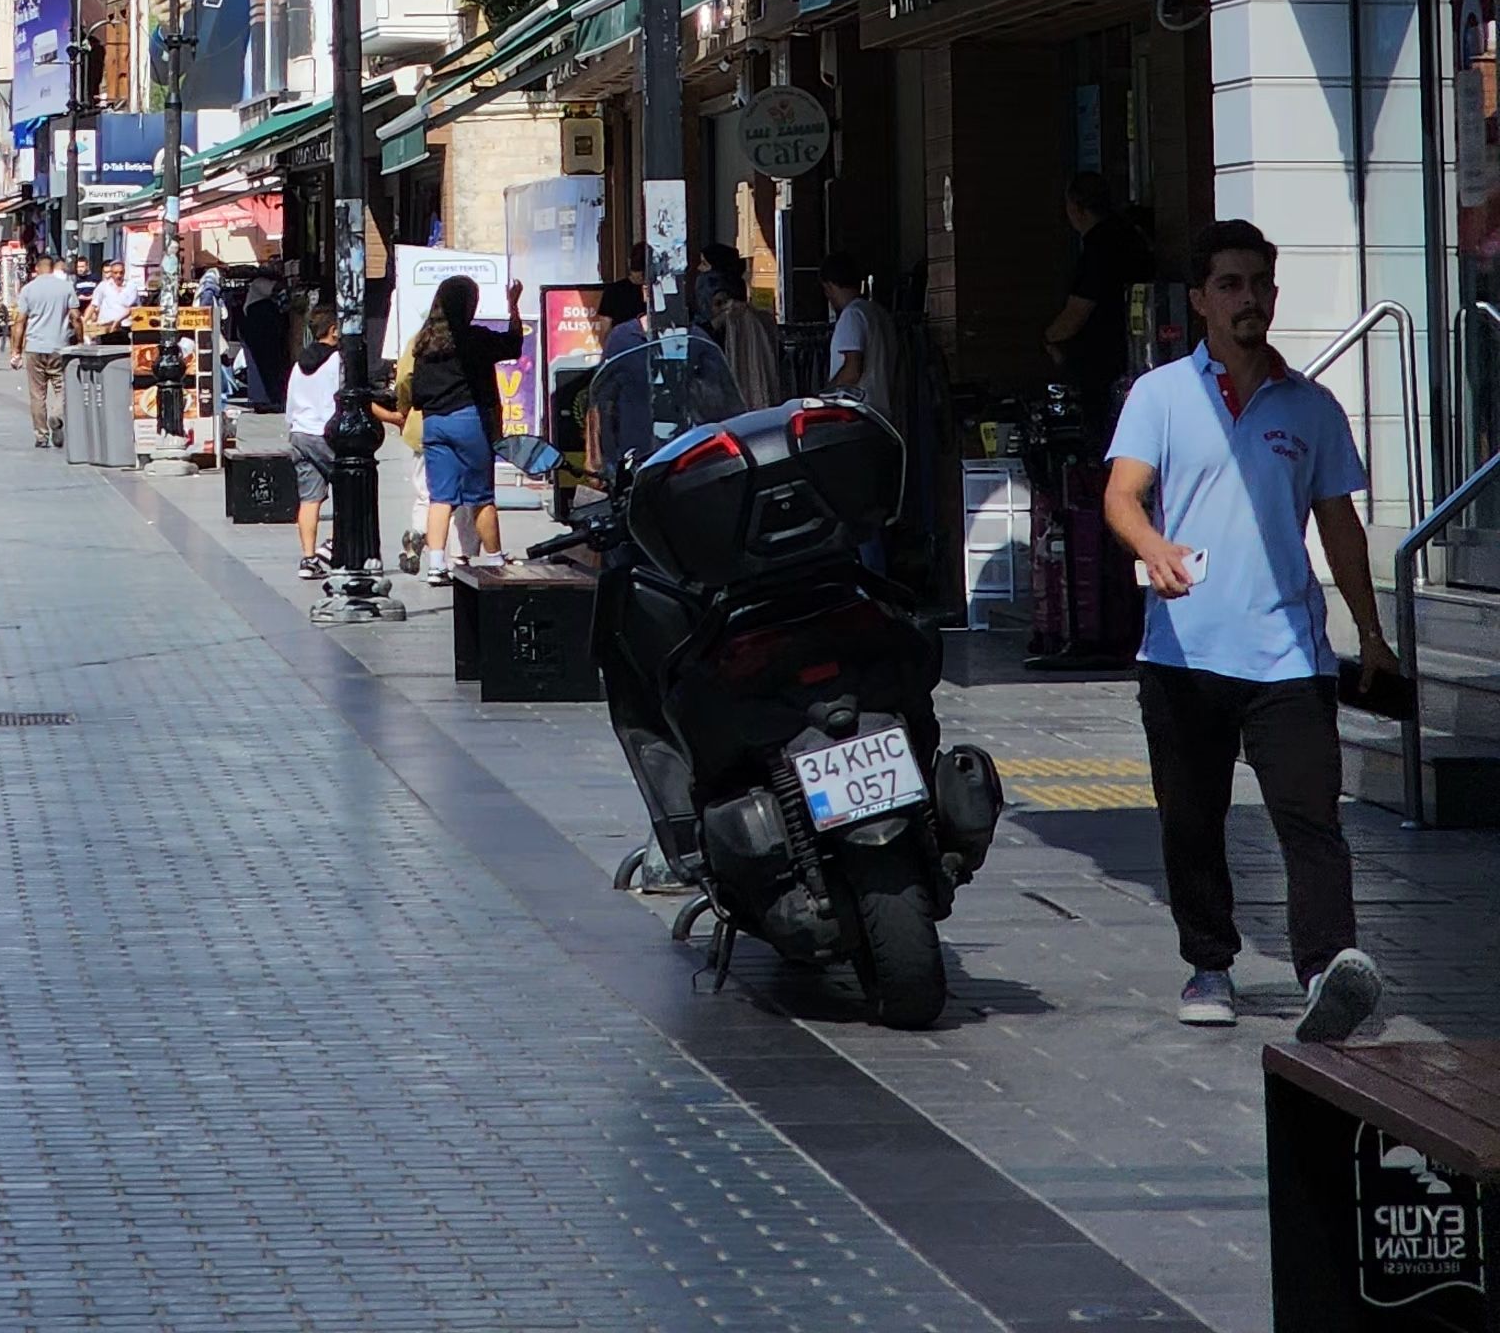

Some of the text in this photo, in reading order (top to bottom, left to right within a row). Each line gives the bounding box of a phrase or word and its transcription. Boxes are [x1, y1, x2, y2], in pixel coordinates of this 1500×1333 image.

[754, 139, 819, 167] Cafe
[802, 733, 904, 783] 34 KHC
[845, 768, 897, 806] 057
